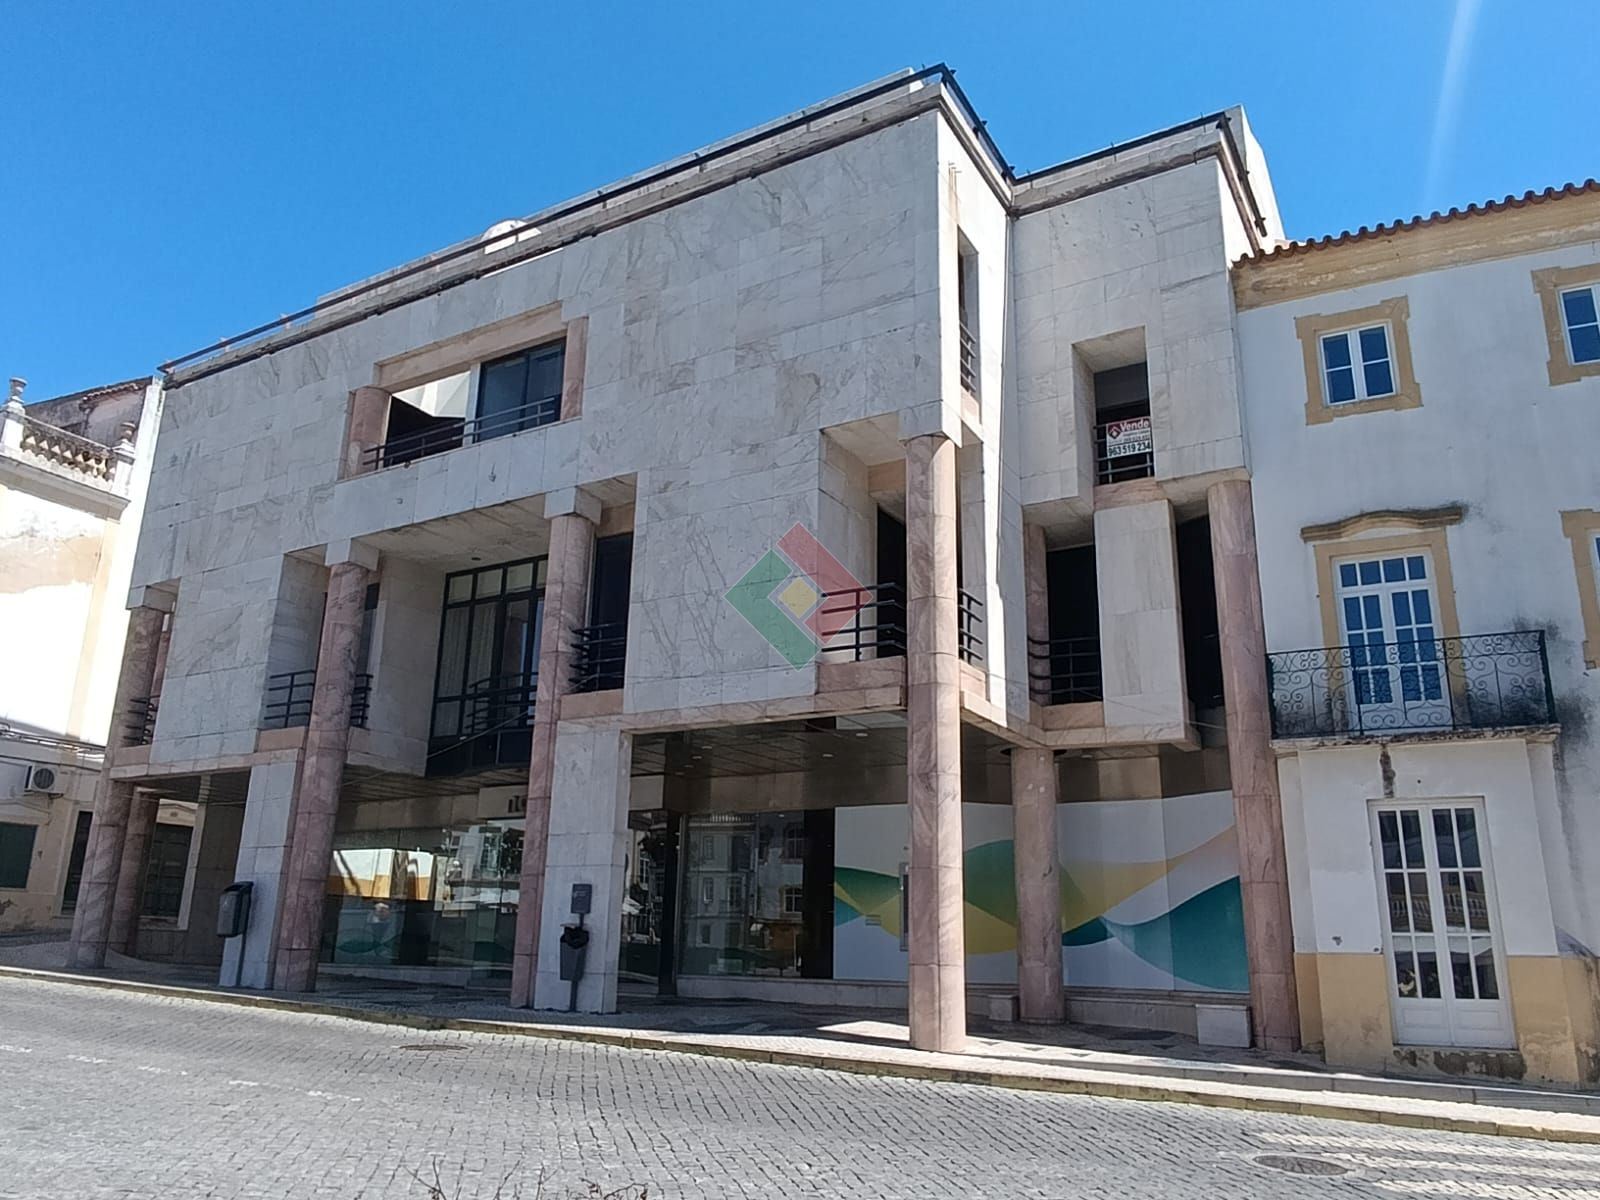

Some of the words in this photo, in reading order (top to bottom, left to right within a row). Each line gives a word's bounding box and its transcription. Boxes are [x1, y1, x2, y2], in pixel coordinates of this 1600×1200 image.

[1120, 419, 1149, 431] Vende
[1122, 444, 1136, 454] 519
[1137, 441, 1151, 451] 234
